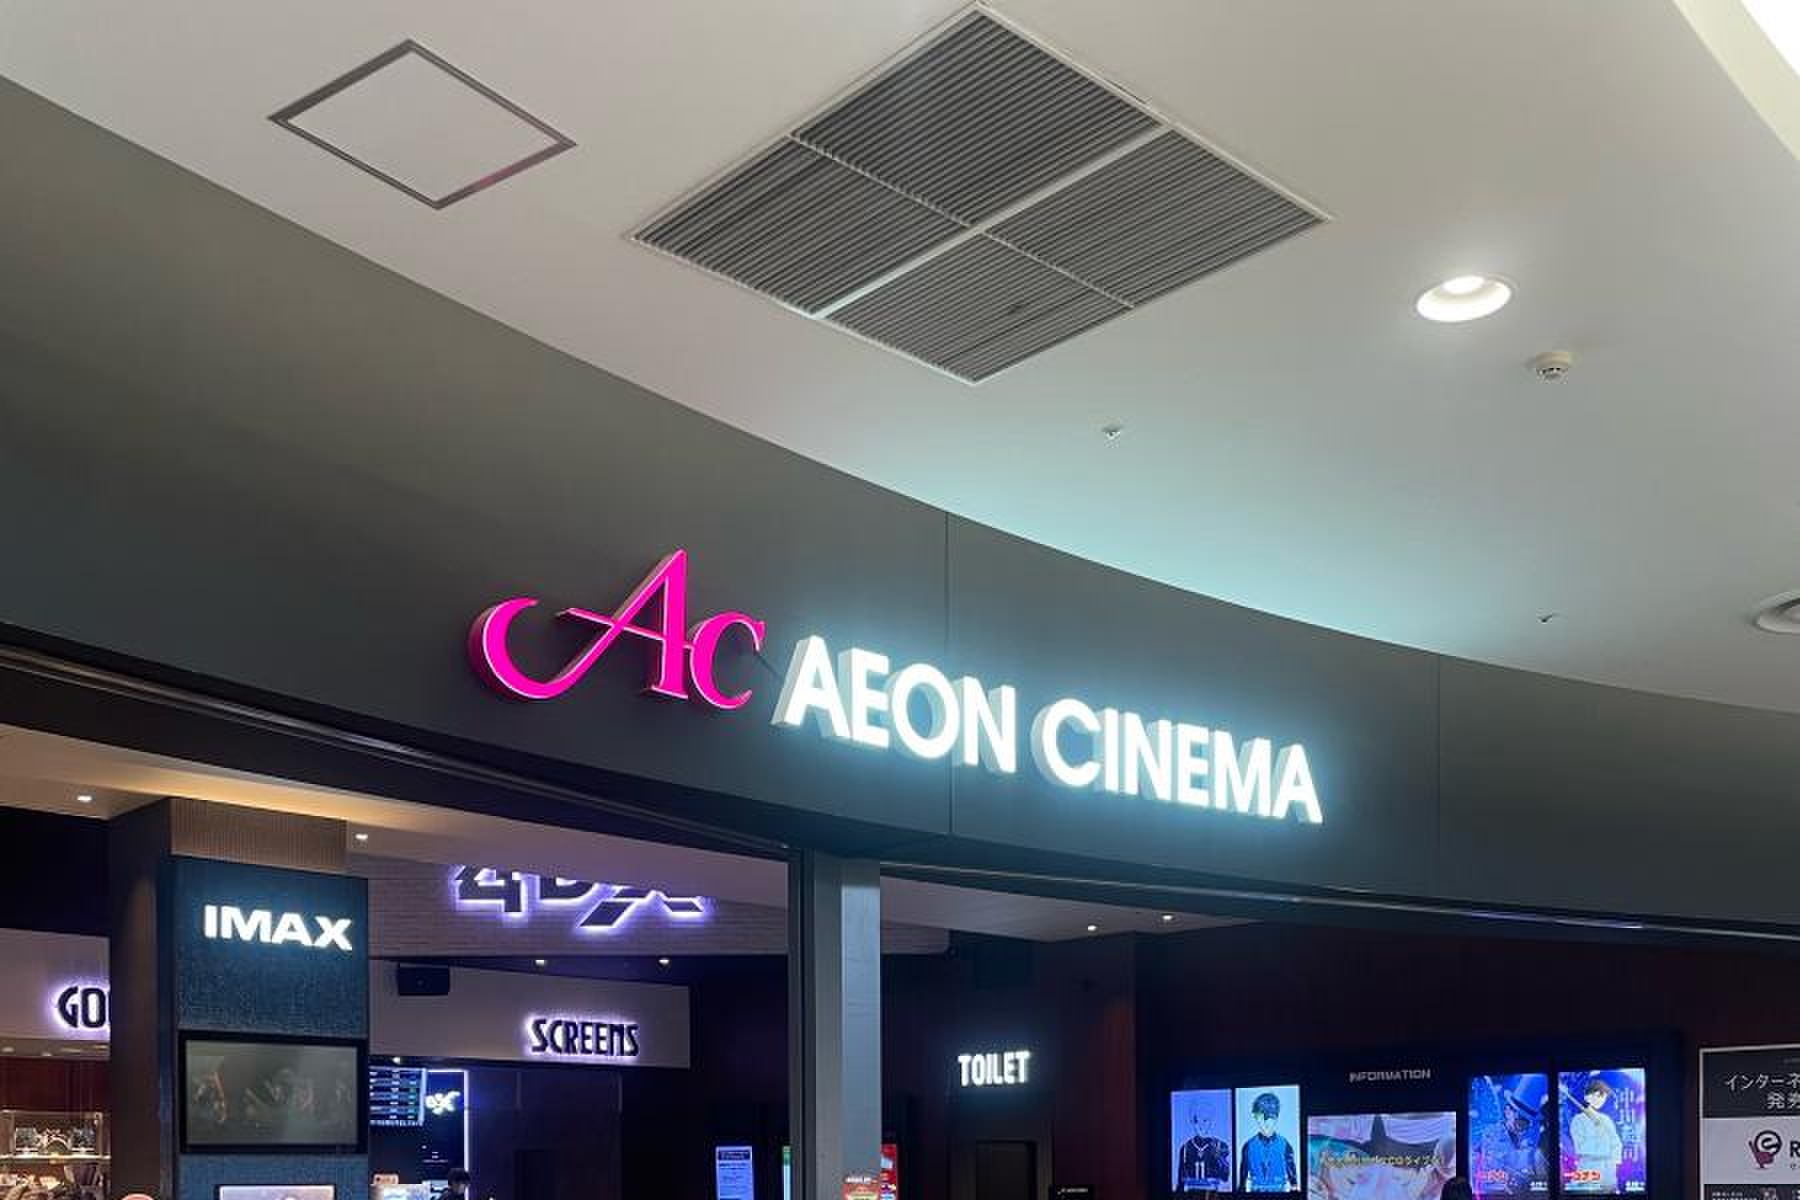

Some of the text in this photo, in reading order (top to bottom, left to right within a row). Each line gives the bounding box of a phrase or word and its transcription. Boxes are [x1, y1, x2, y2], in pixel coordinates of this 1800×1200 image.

[772, 635, 1017, 774] AEON
[1031, 697, 1324, 825] CINEMA
[204, 904, 353, 951] IMAX
[57, 985, 112, 1029] GO
[531, 1018, 639, 1057] SCREENS
[958, 1050, 1031, 1087] TOILET
[1348, 1068, 1431, 1083] INFORMATION
